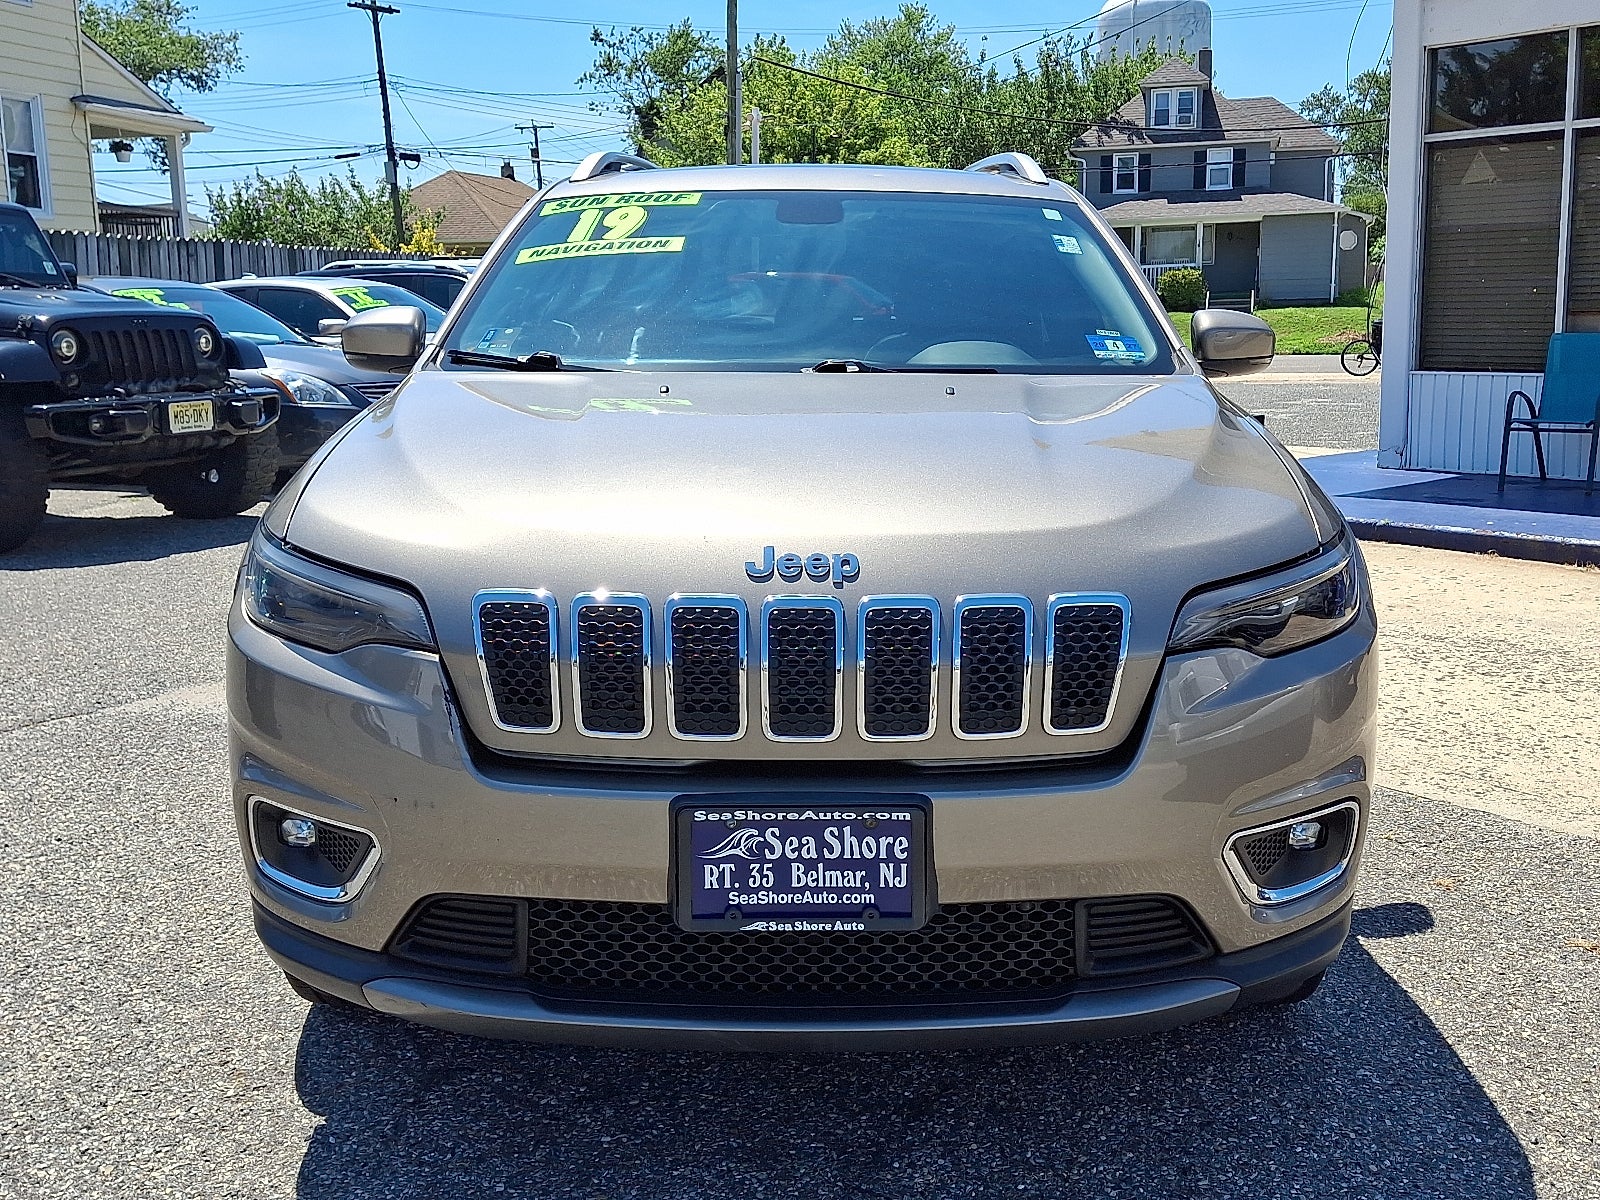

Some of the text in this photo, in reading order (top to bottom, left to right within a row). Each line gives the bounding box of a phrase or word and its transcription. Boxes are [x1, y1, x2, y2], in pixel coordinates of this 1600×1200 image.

[551, 193, 693, 211] SUN ROOF
[566, 205, 648, 242] 19
[528, 239, 671, 259] NAVIGATION
[744, 545, 860, 589] Jeep
[693, 810, 911, 821] SeaShoreAuto.com
[764, 825, 909, 859] Sea Shore
[703, 862, 908, 891] RT. 35 Belmar, NJ
[728, 891, 875, 905] SeaShoreAuto.com
[768, 920, 865, 931] Sea Shore Auto
